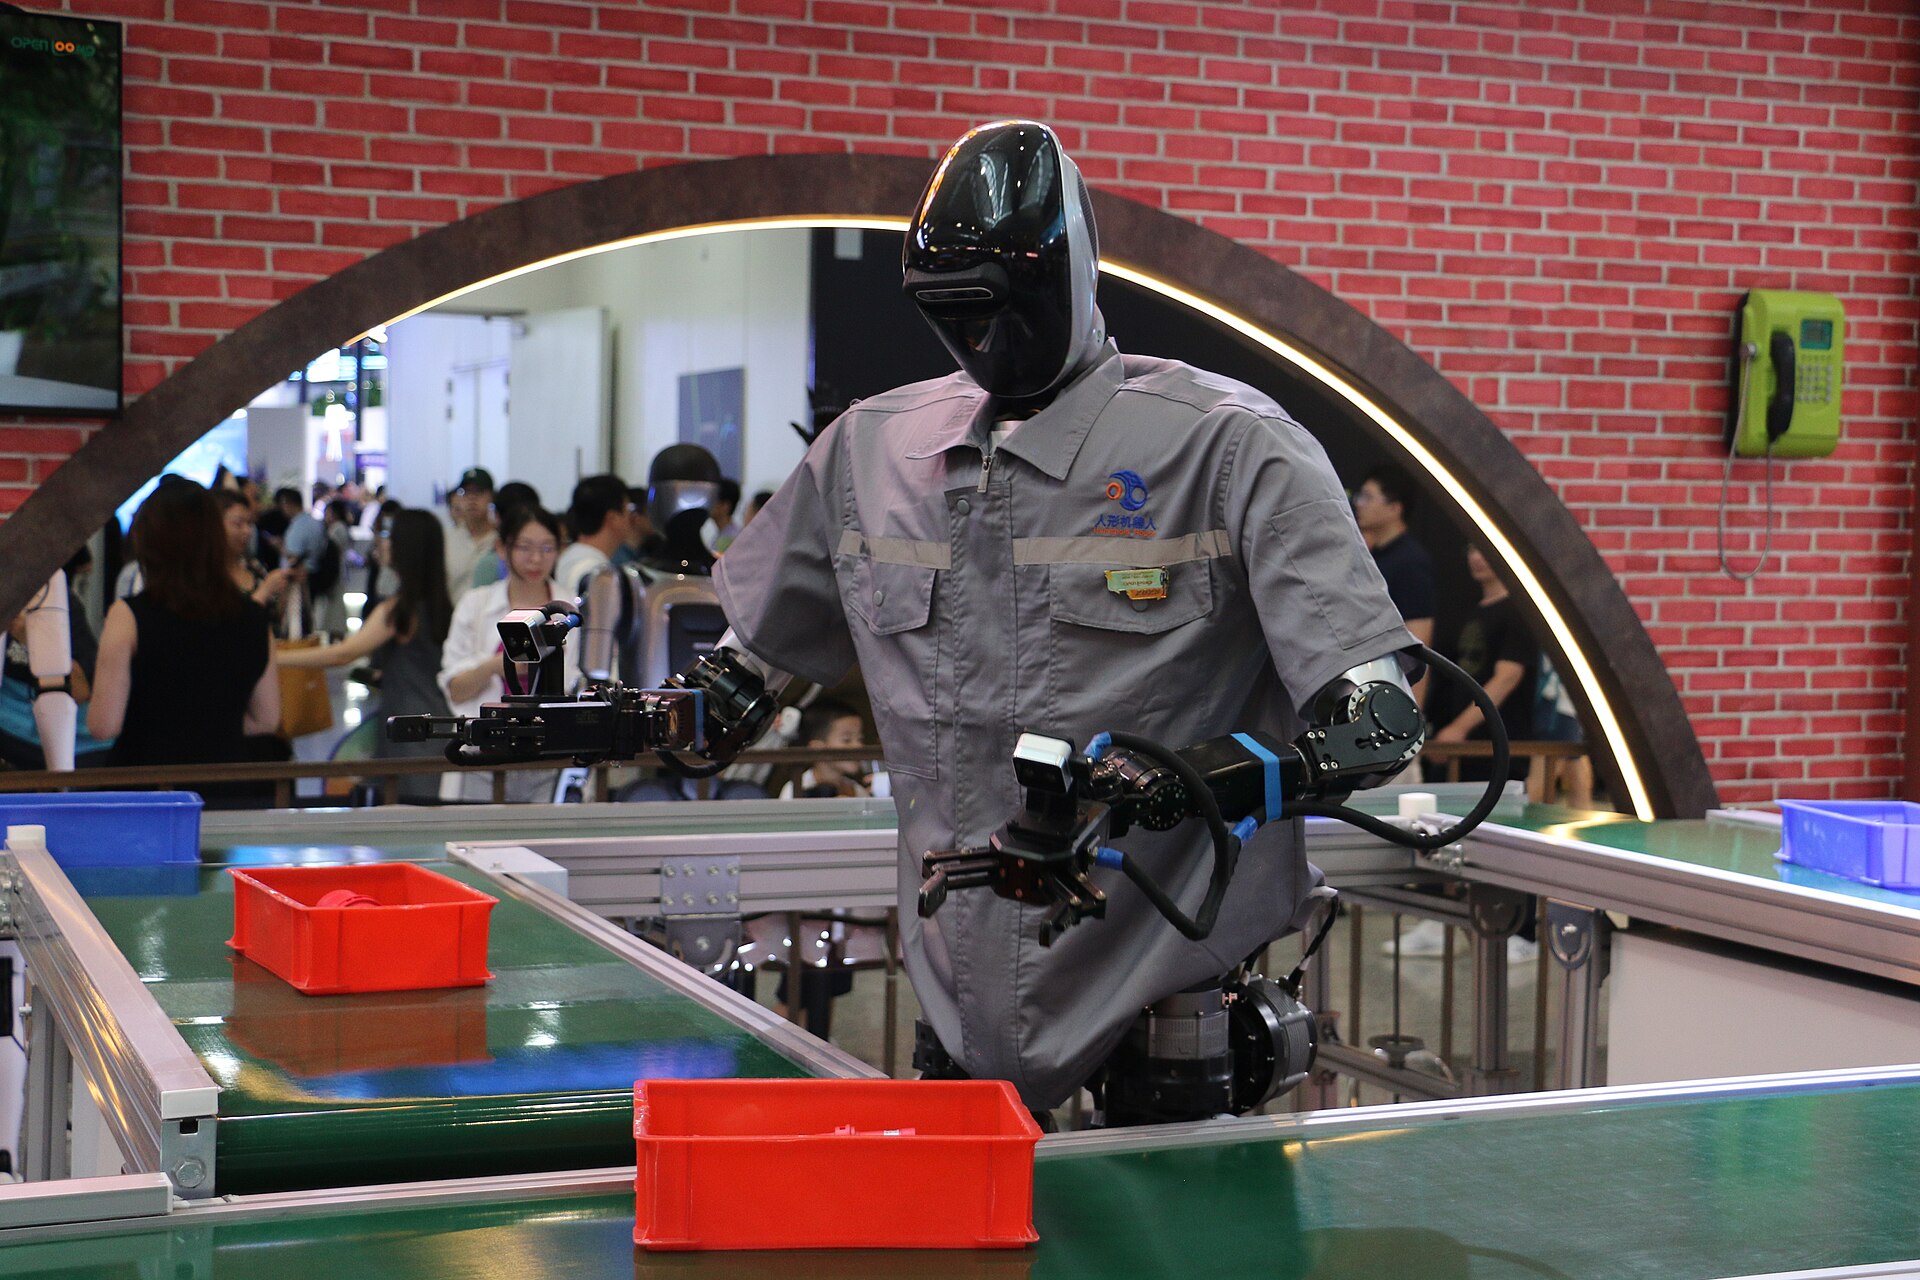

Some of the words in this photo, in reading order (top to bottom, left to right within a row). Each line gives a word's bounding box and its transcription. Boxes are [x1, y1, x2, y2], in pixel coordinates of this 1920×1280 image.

[1094, 513, 1156, 530] 人形机器人
